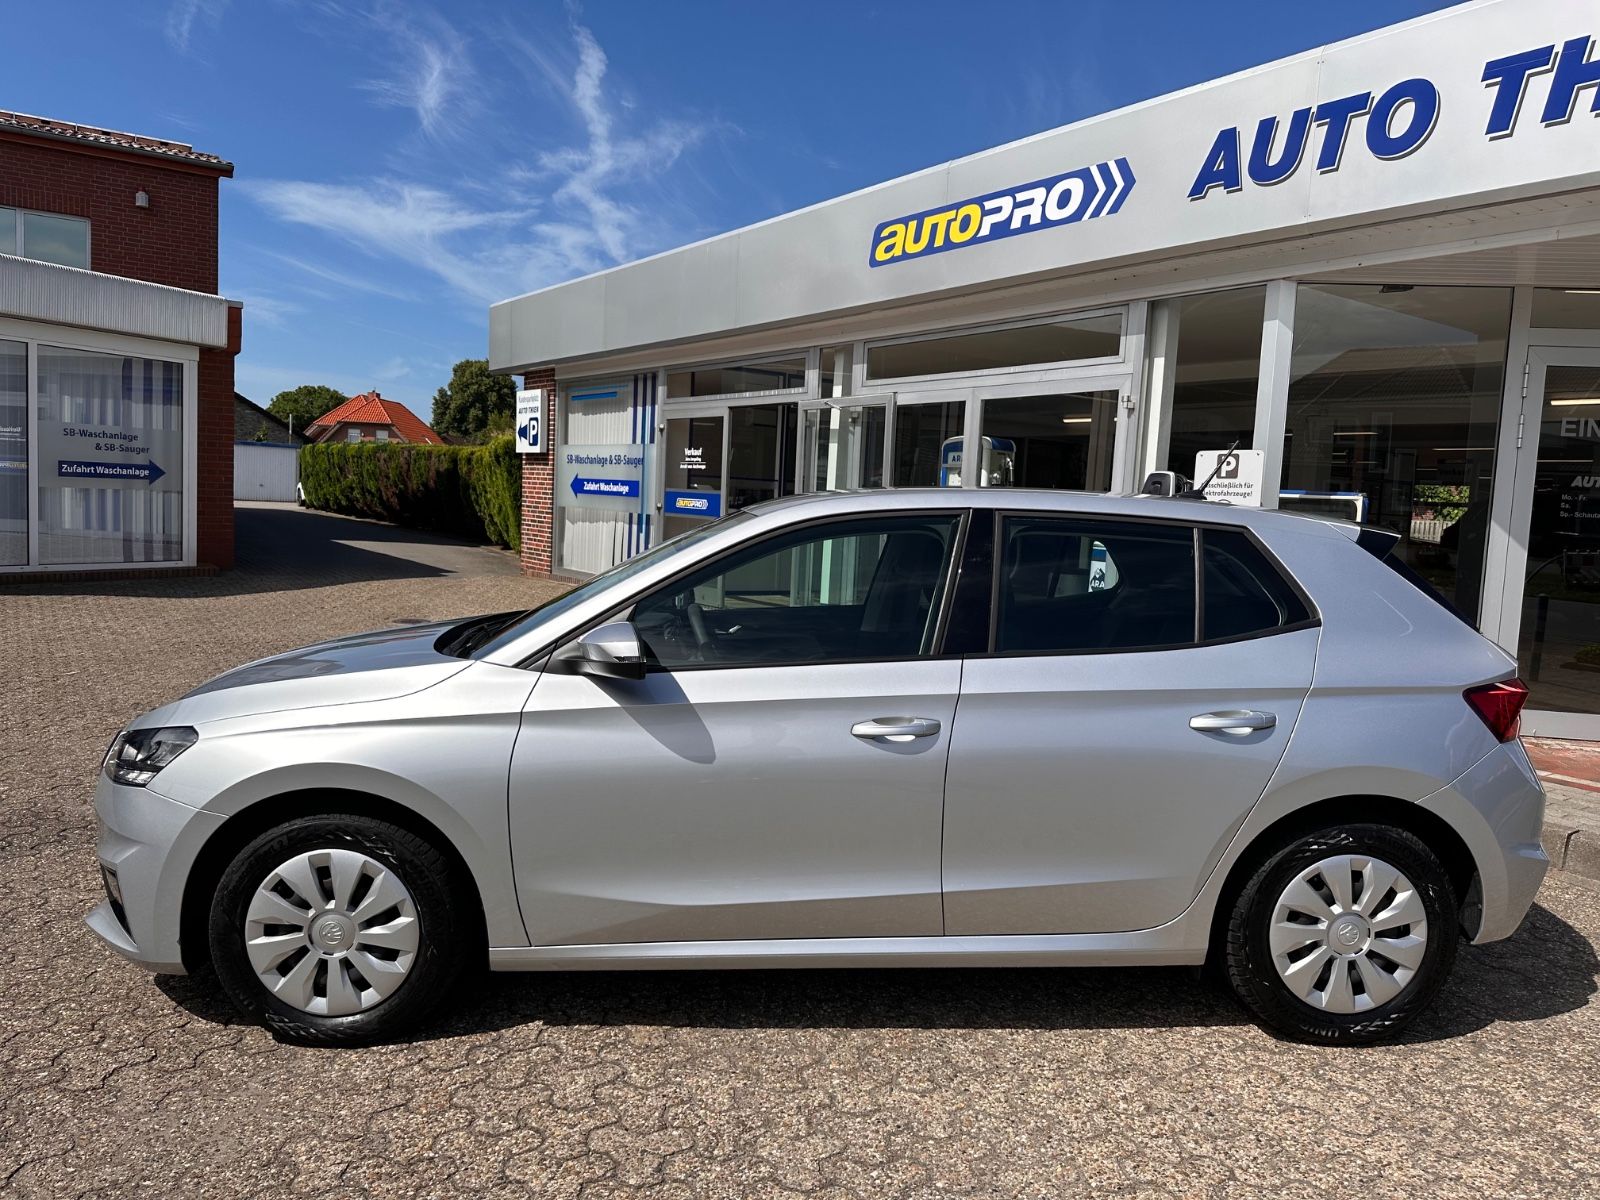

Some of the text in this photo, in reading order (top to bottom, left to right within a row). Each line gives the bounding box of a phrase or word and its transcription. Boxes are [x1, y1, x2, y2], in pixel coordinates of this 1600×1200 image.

[1187, 77, 1441, 202] AUTO
[63, 427, 139, 442] SB-Waschanlage
[530, 420, 538, 444] P
[95, 442, 150, 455] & SB-Sauger
[684, 447, 702, 456] Verkauf
[566, 453, 644, 468] SB-Waschanlage & SB-Sauger
[1220, 456, 1236, 477] P
[61, 464, 150, 477] Zufahrt Waschanlage
[583, 481, 630, 495] Zufahrt Waschanlage
[1202, 482, 1243, 490] sschließlich
[1203, 490, 1253, 498] lektrofahrzeuge!
